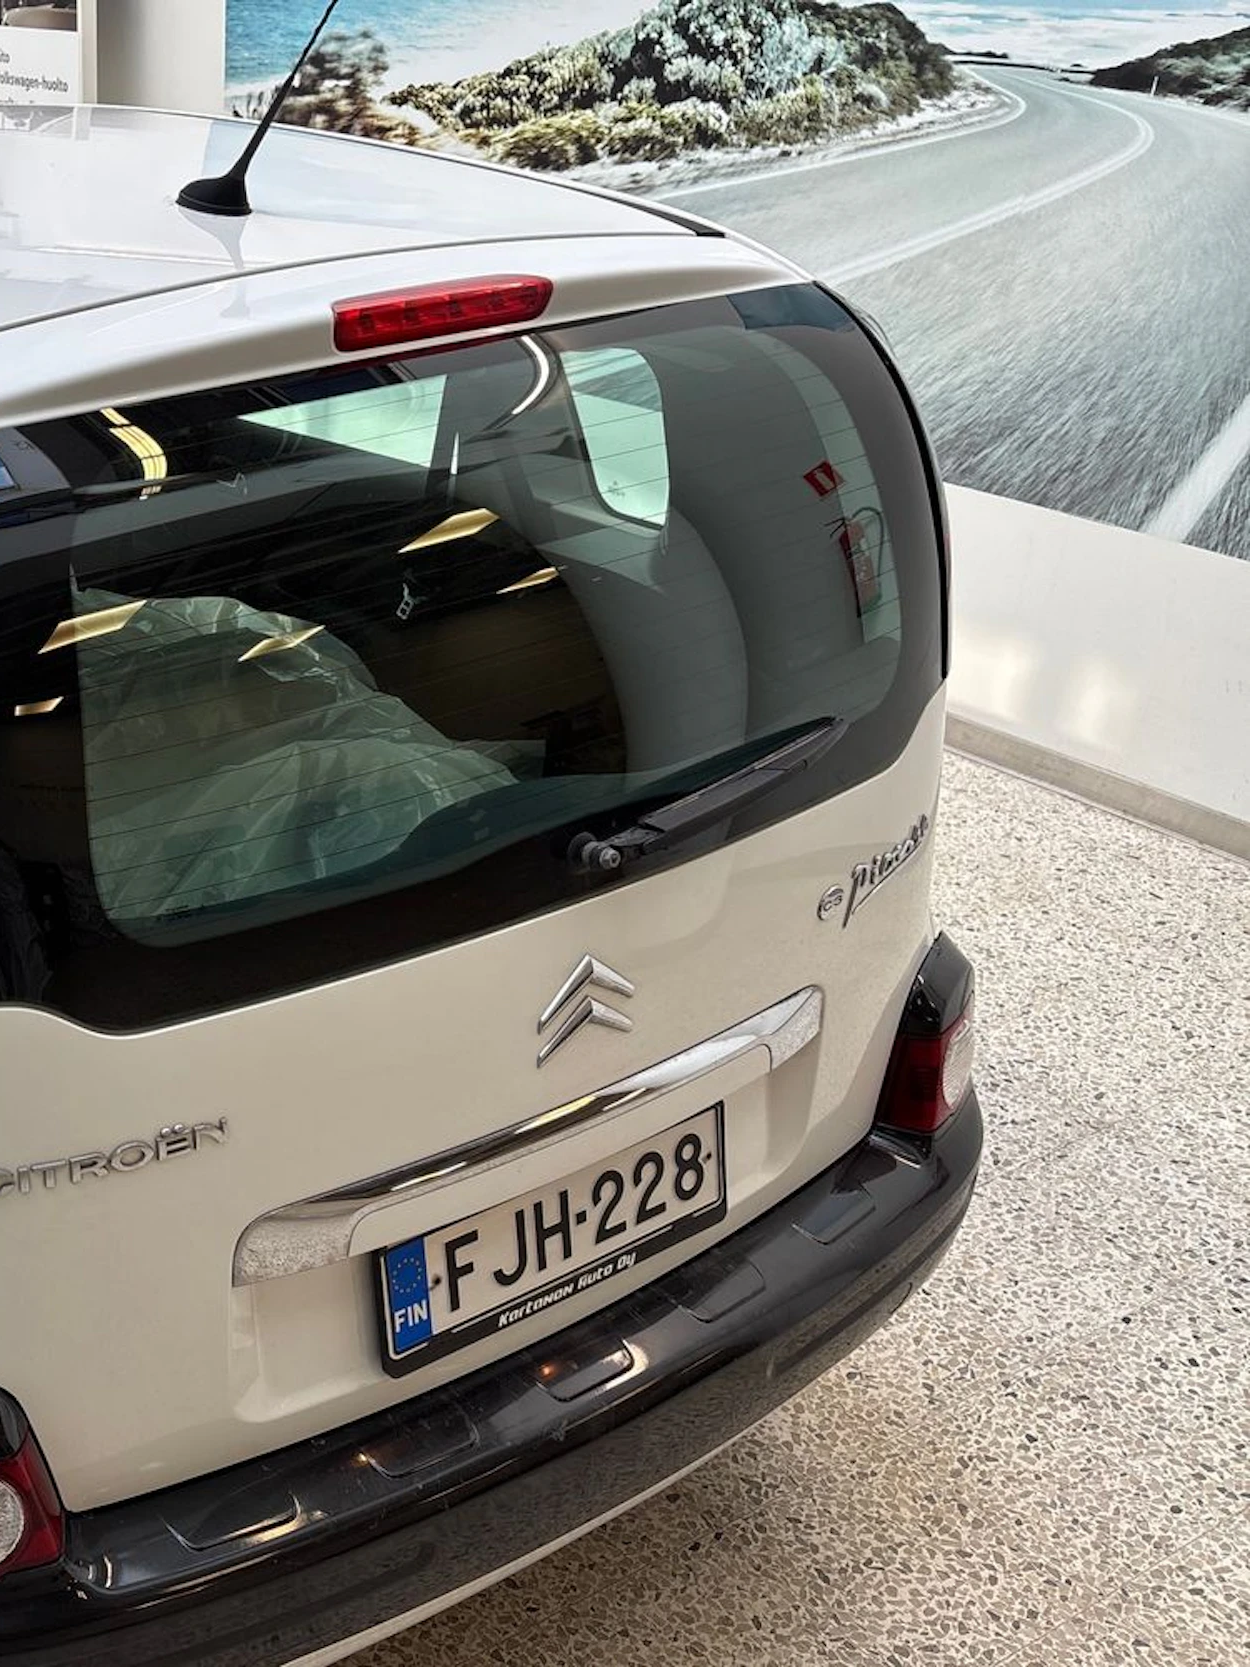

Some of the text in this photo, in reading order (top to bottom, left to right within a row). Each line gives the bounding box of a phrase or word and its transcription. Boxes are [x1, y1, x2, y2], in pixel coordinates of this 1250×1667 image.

[444, 1132, 705, 1313] FJH-228
[577, 1263, 614, 1290] Auto
[616, 1251, 637, 1270] Oy
[393, 1298, 429, 1334] FIN
